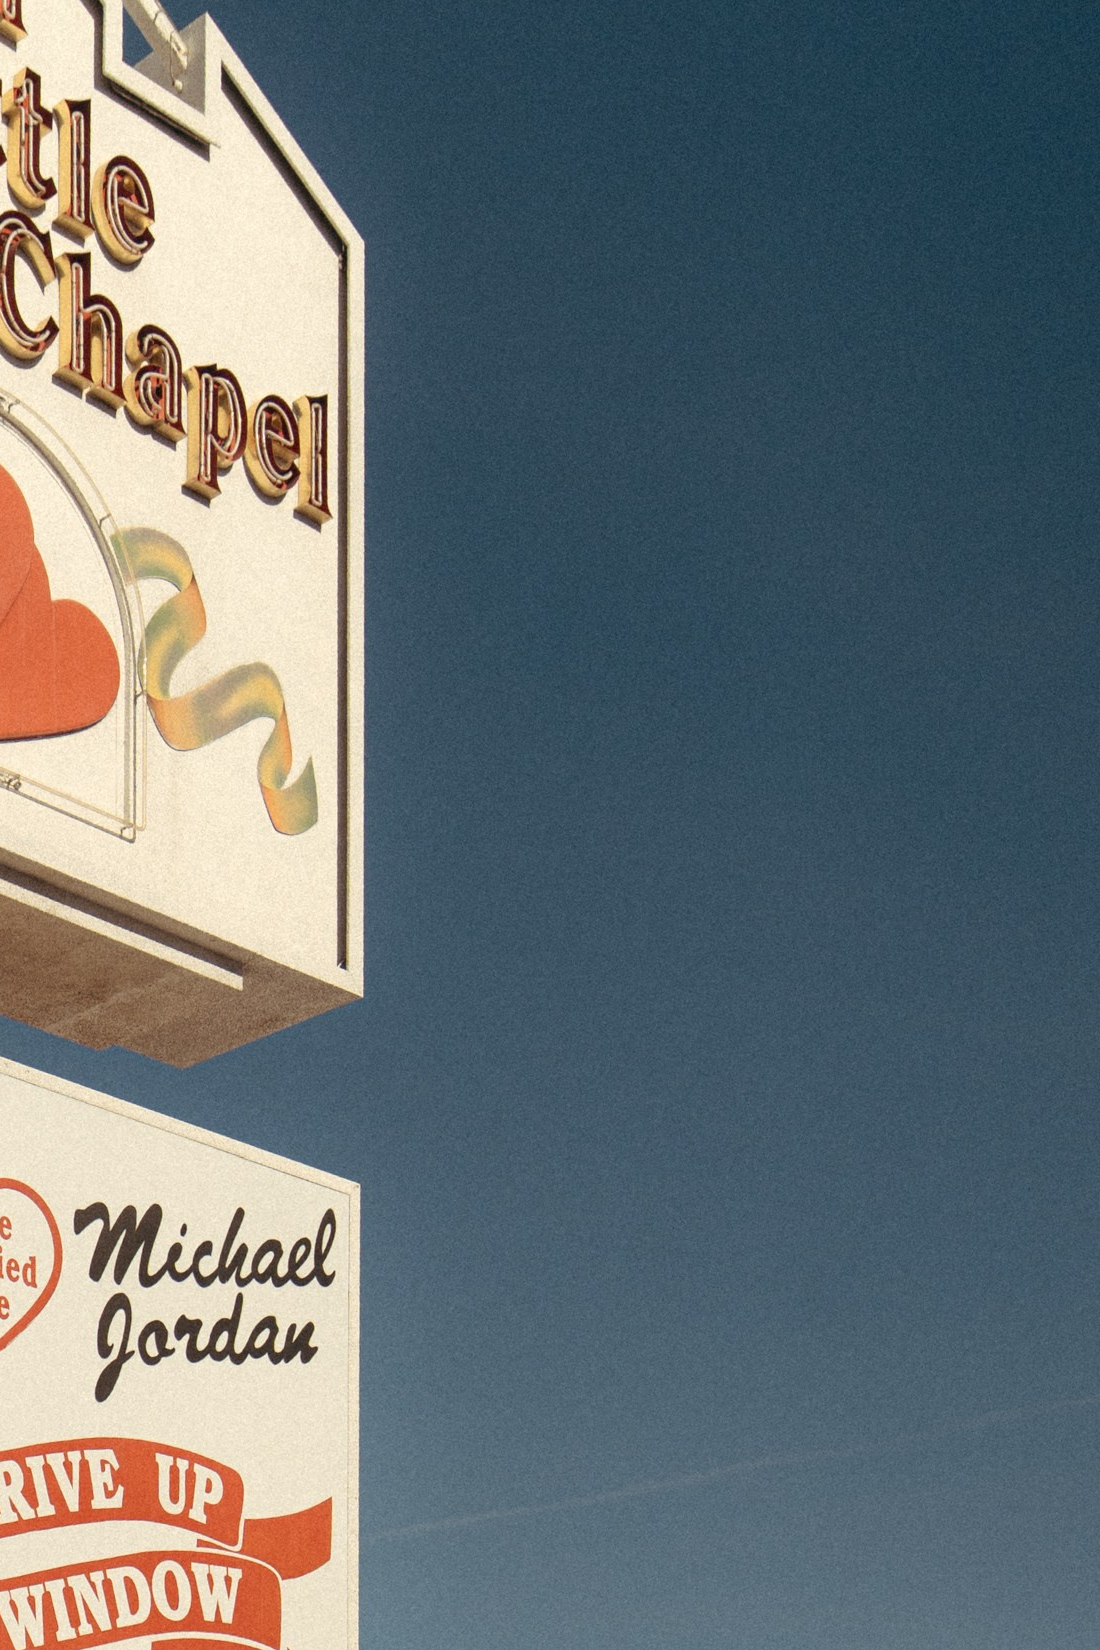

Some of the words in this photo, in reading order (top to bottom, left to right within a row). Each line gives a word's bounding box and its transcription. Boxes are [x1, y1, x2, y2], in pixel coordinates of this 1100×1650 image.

[74, 1201, 336, 1289] Michael
[94, 1292, 318, 1402] Jordan
[155, 1452, 225, 1525] UP
